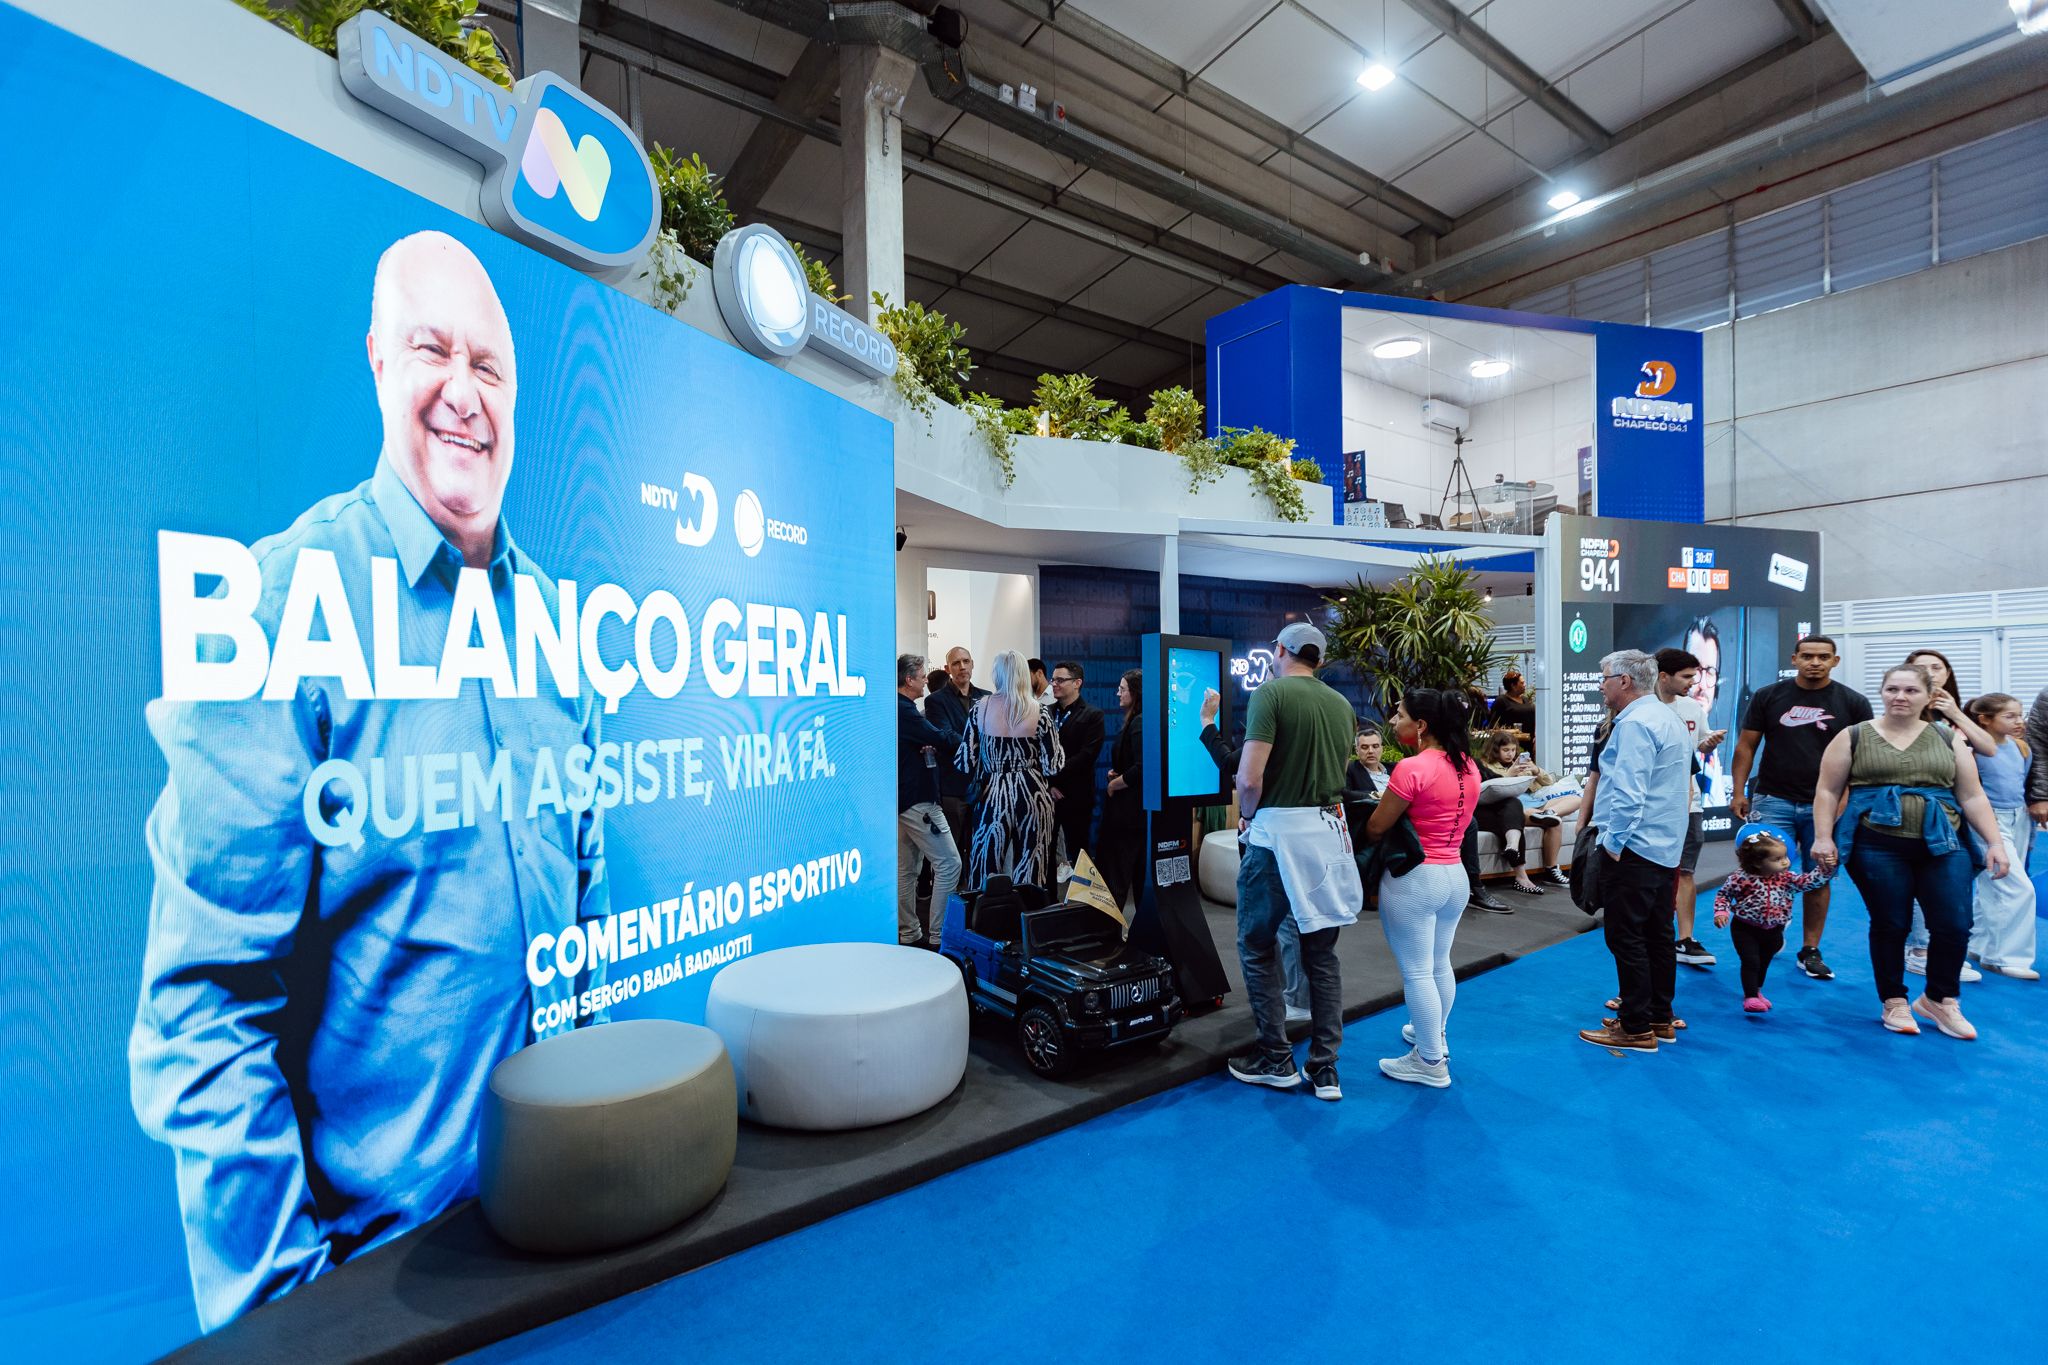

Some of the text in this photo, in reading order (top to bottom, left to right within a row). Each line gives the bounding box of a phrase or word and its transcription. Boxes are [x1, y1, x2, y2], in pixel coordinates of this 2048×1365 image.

[374, 26, 517, 143] NDTV
[815, 303, 894, 369] RECORD
[1612, 396, 1693, 422] NDFM
[1613, 418, 1667, 431] CHAPECÓ
[641, 482, 678, 511] NDTV
[767, 518, 807, 545] RECORD
[1580, 538, 1609, 549] NDFM
[1580, 558, 1620, 592] 94.1
[1671, 571, 1686, 583] CHA
[1712, 573, 1727, 585] BOT
[157, 529, 866, 714] BALANÇO GERAL.
[1584, 703, 1600, 712] PAULO
[304, 716, 836, 852] QUEM ASSISTE, VIRA FÃ.
[1708, 816, 1725, 830] SÉRIE
[1157, 840, 1180, 849] NDFM
[526, 848, 862, 987] COMENTÁRIO ESPORTIVO
[532, 934, 752, 1033] COM SERGIO BADÁ BADALOTTI
